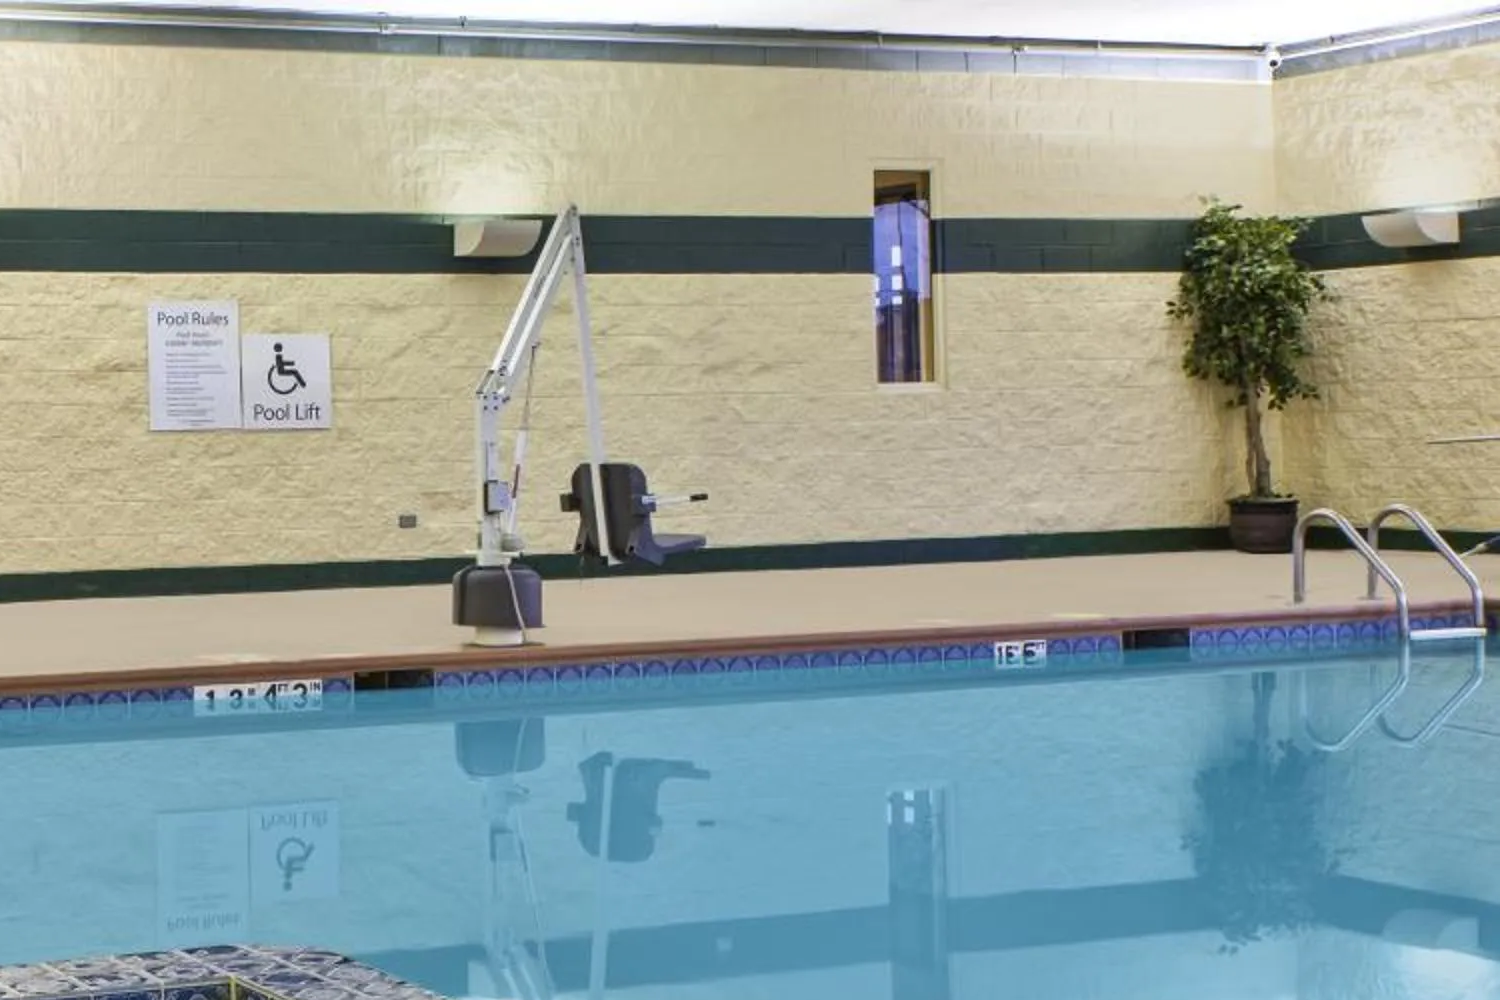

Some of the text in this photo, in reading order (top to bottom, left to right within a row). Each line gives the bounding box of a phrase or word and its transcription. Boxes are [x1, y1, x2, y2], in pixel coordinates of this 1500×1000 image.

[157, 312, 229, 326] Pool Rules
[253, 402, 321, 421] Pool Lift
